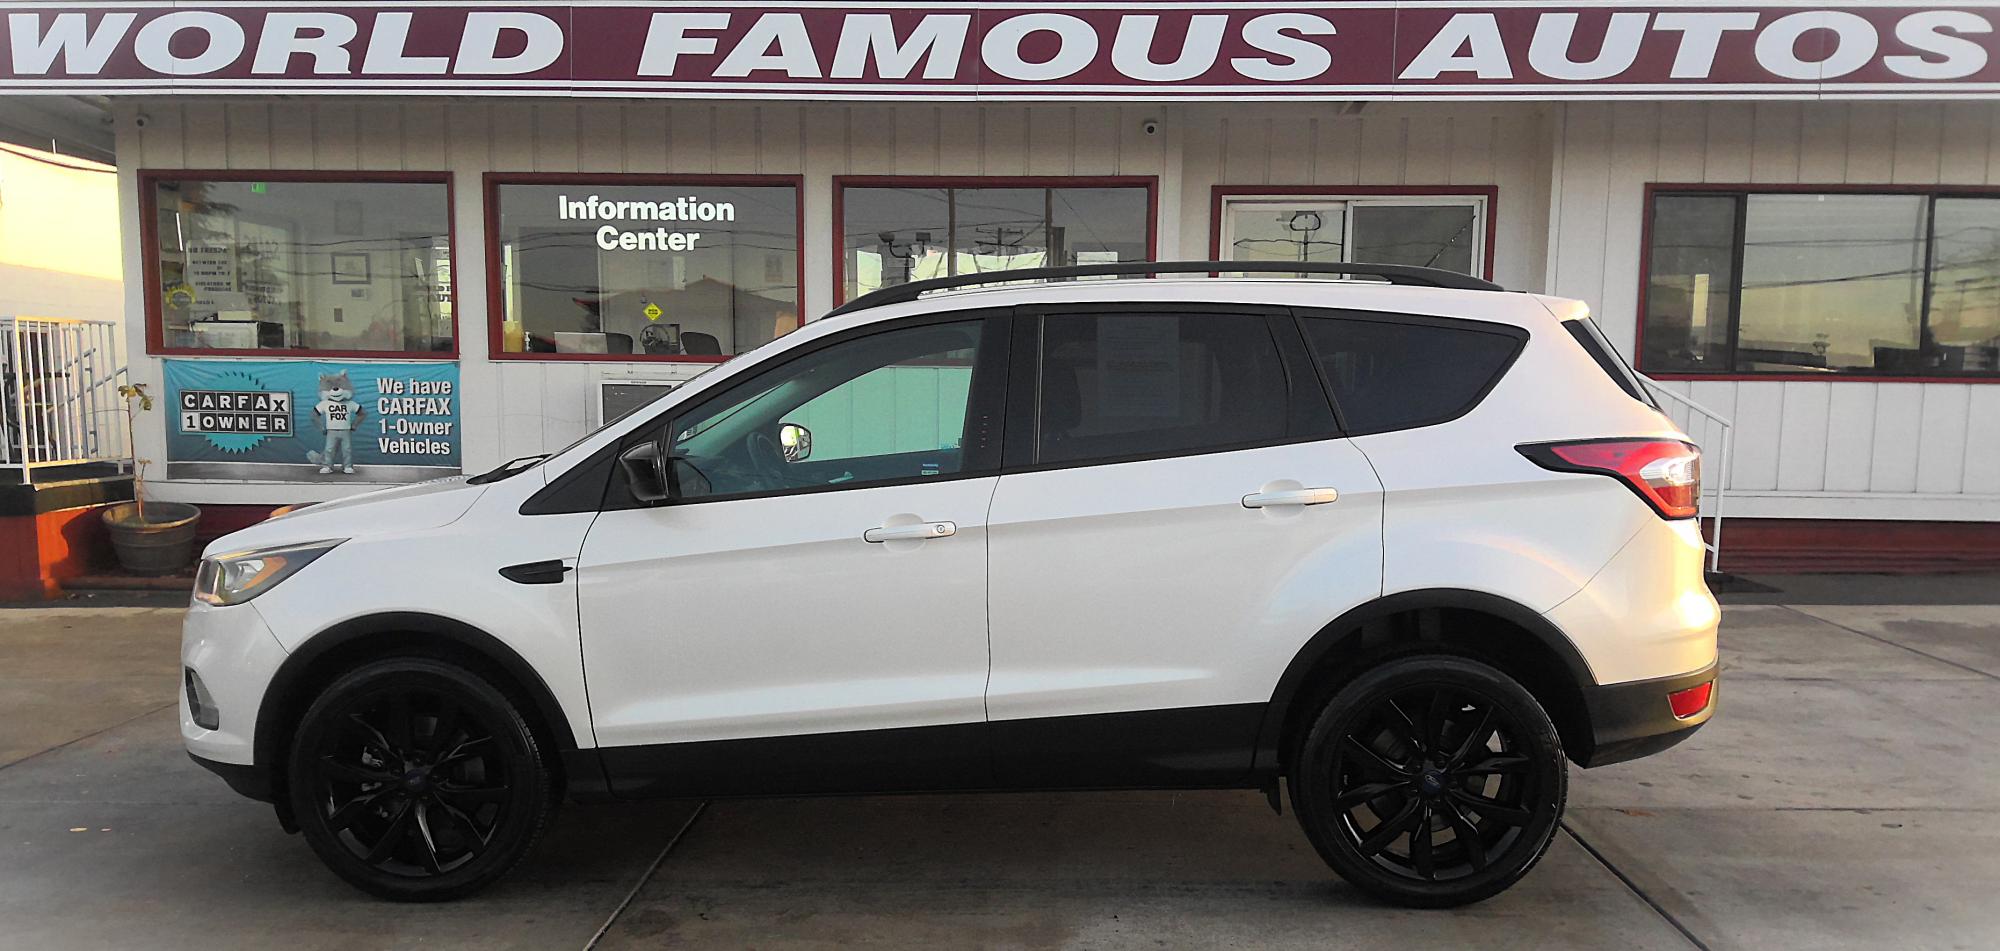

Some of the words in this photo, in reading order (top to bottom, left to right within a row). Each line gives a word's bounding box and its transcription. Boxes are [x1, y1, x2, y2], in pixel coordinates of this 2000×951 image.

[7, 12, 564, 75] WORLD
[636, 12, 1337, 82] FAMOUS
[1399, 11, 1993, 80] AUTOS
[558, 195, 735, 221] Information
[596, 225, 700, 250] Center
[376, 377, 404, 395] We
[409, 377, 452, 395] have
[184, 394, 286, 412] CARFAX
[328, 405, 347, 413] CAR
[377, 397, 451, 416] CARFAX
[330, 412, 347, 421] FOX
[378, 418, 453, 435] 1-Owner
[378, 438, 451, 455] Vehicles
